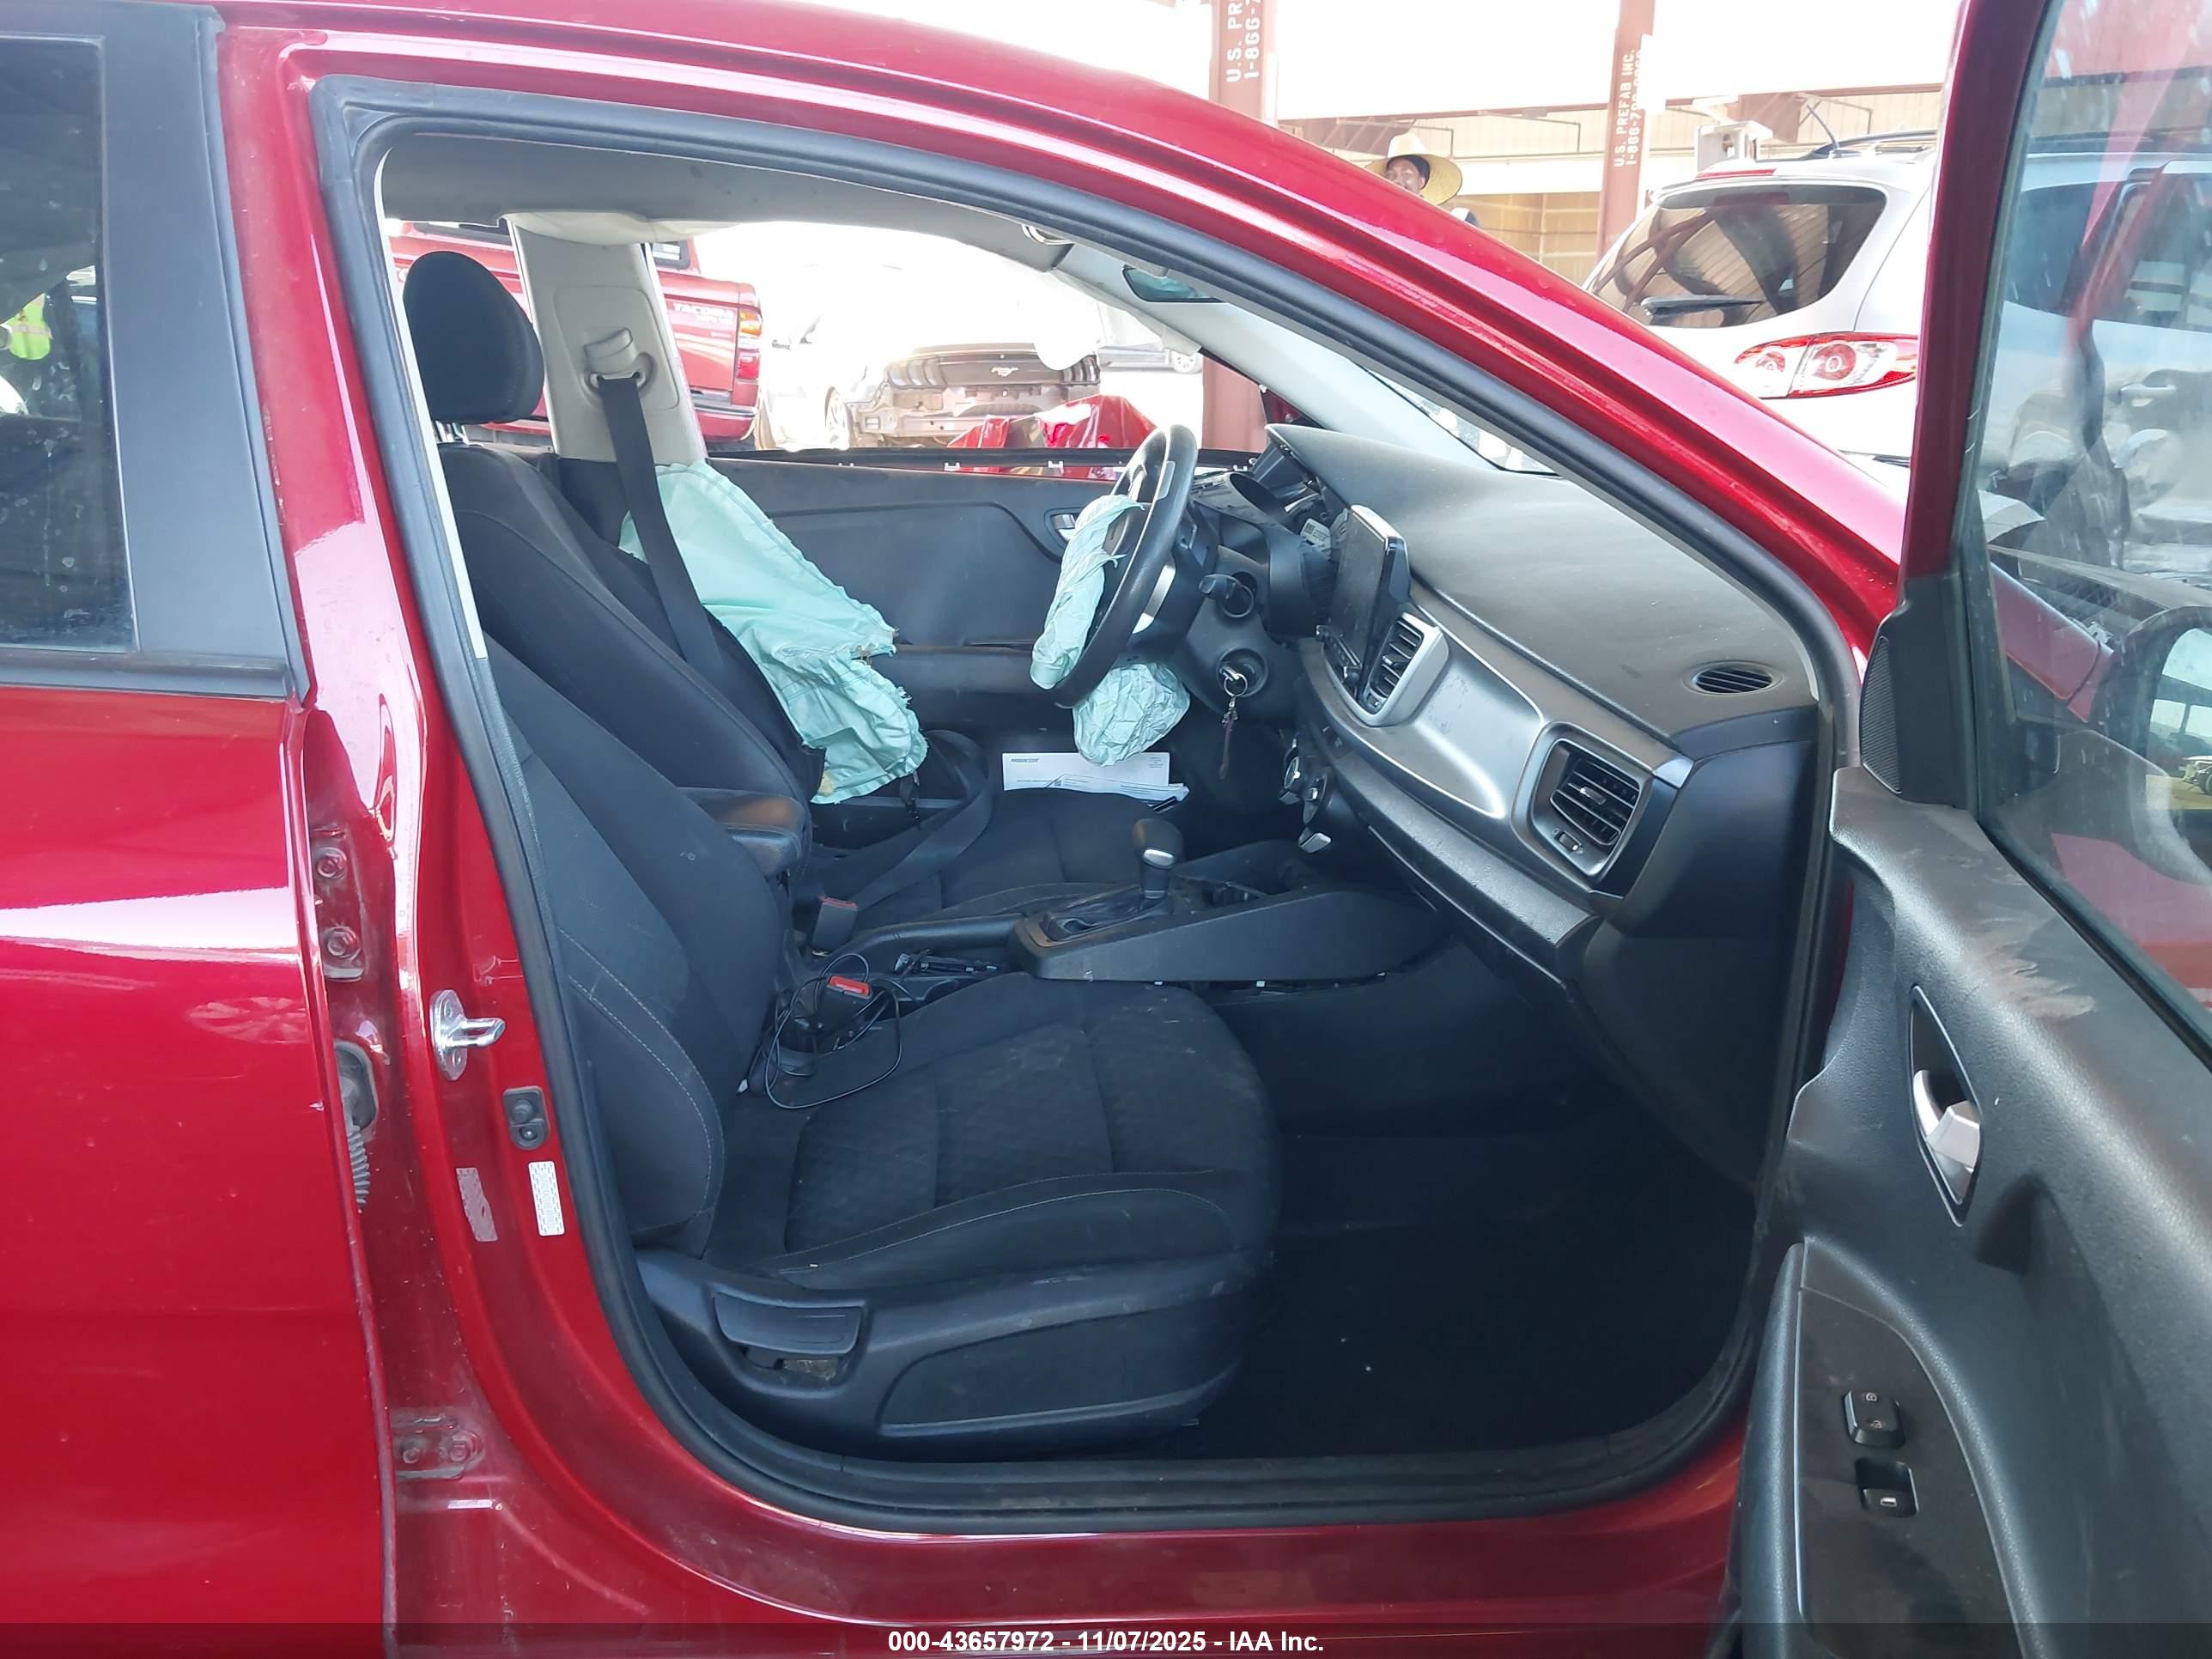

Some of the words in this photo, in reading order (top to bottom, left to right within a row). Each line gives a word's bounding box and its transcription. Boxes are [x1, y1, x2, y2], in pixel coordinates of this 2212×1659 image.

[1227, 0, 1243, 29] PR
[1225, 40, 1243, 82] U.S.
[1621, 49, 1636, 76] INC.
[1616, 82, 1632, 135] PREFAB
[1613, 141, 1627, 167] U.S.
